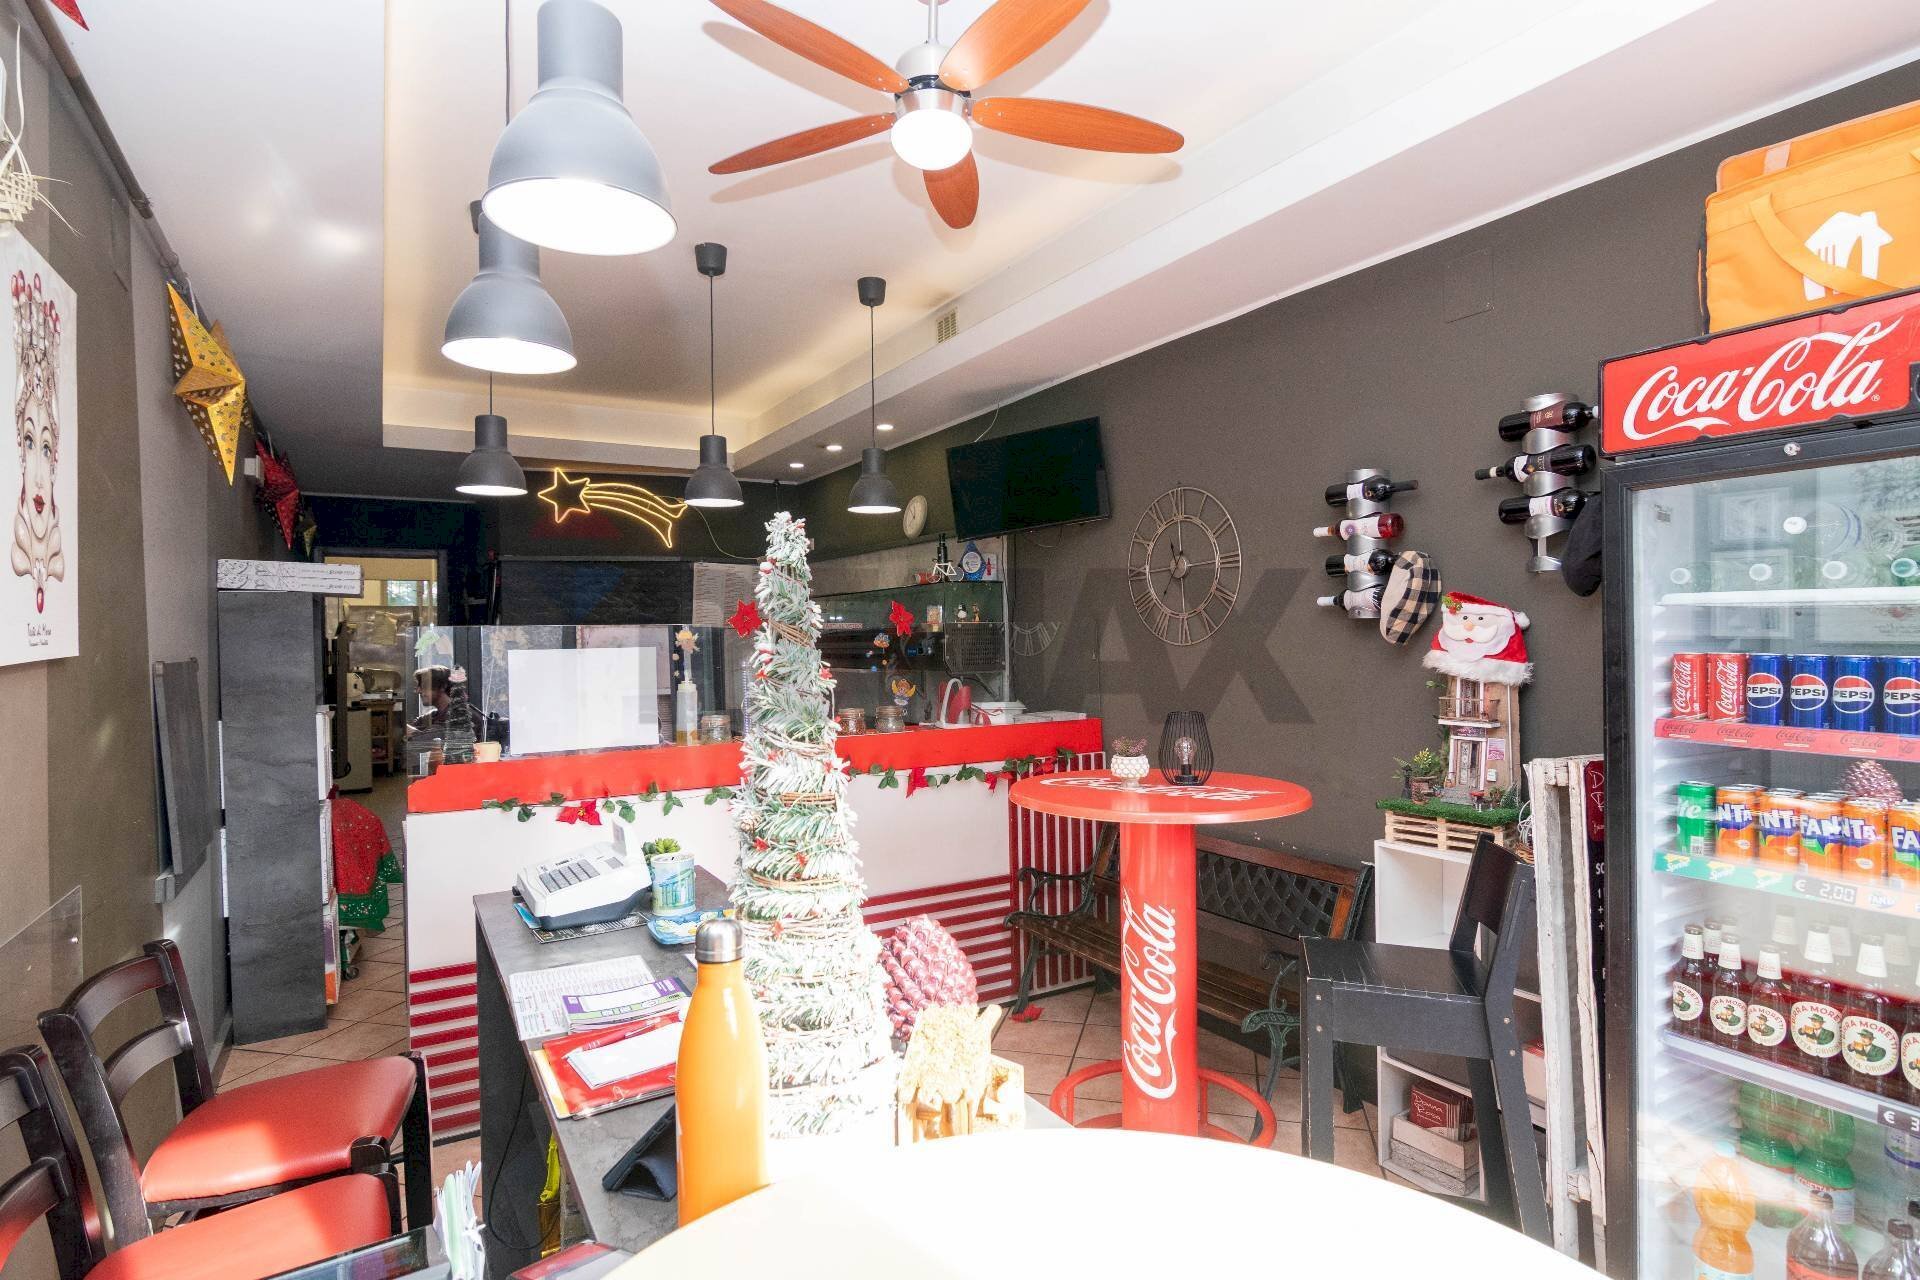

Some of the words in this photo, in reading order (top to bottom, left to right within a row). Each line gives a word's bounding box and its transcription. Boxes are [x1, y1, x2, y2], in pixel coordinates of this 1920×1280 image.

[1623, 315, 1905, 441] Coca-Cola
[1674, 658, 1691, 713] Coca-Cola
[1715, 658, 1738, 716] Coca-Cola
[1746, 686, 1781, 695] PEPSI
[1790, 688, 1825, 697] PEPSI
[1834, 690, 1872, 700] PEPSI
[1884, 692, 1920, 701] PEPS
[1717, 803, 1752, 822] NTA
[1799, 814, 1841, 836] FAN
[1121, 886, 1179, 1100] Coca-Cola
[1810, 1005, 1841, 1022] MORE
